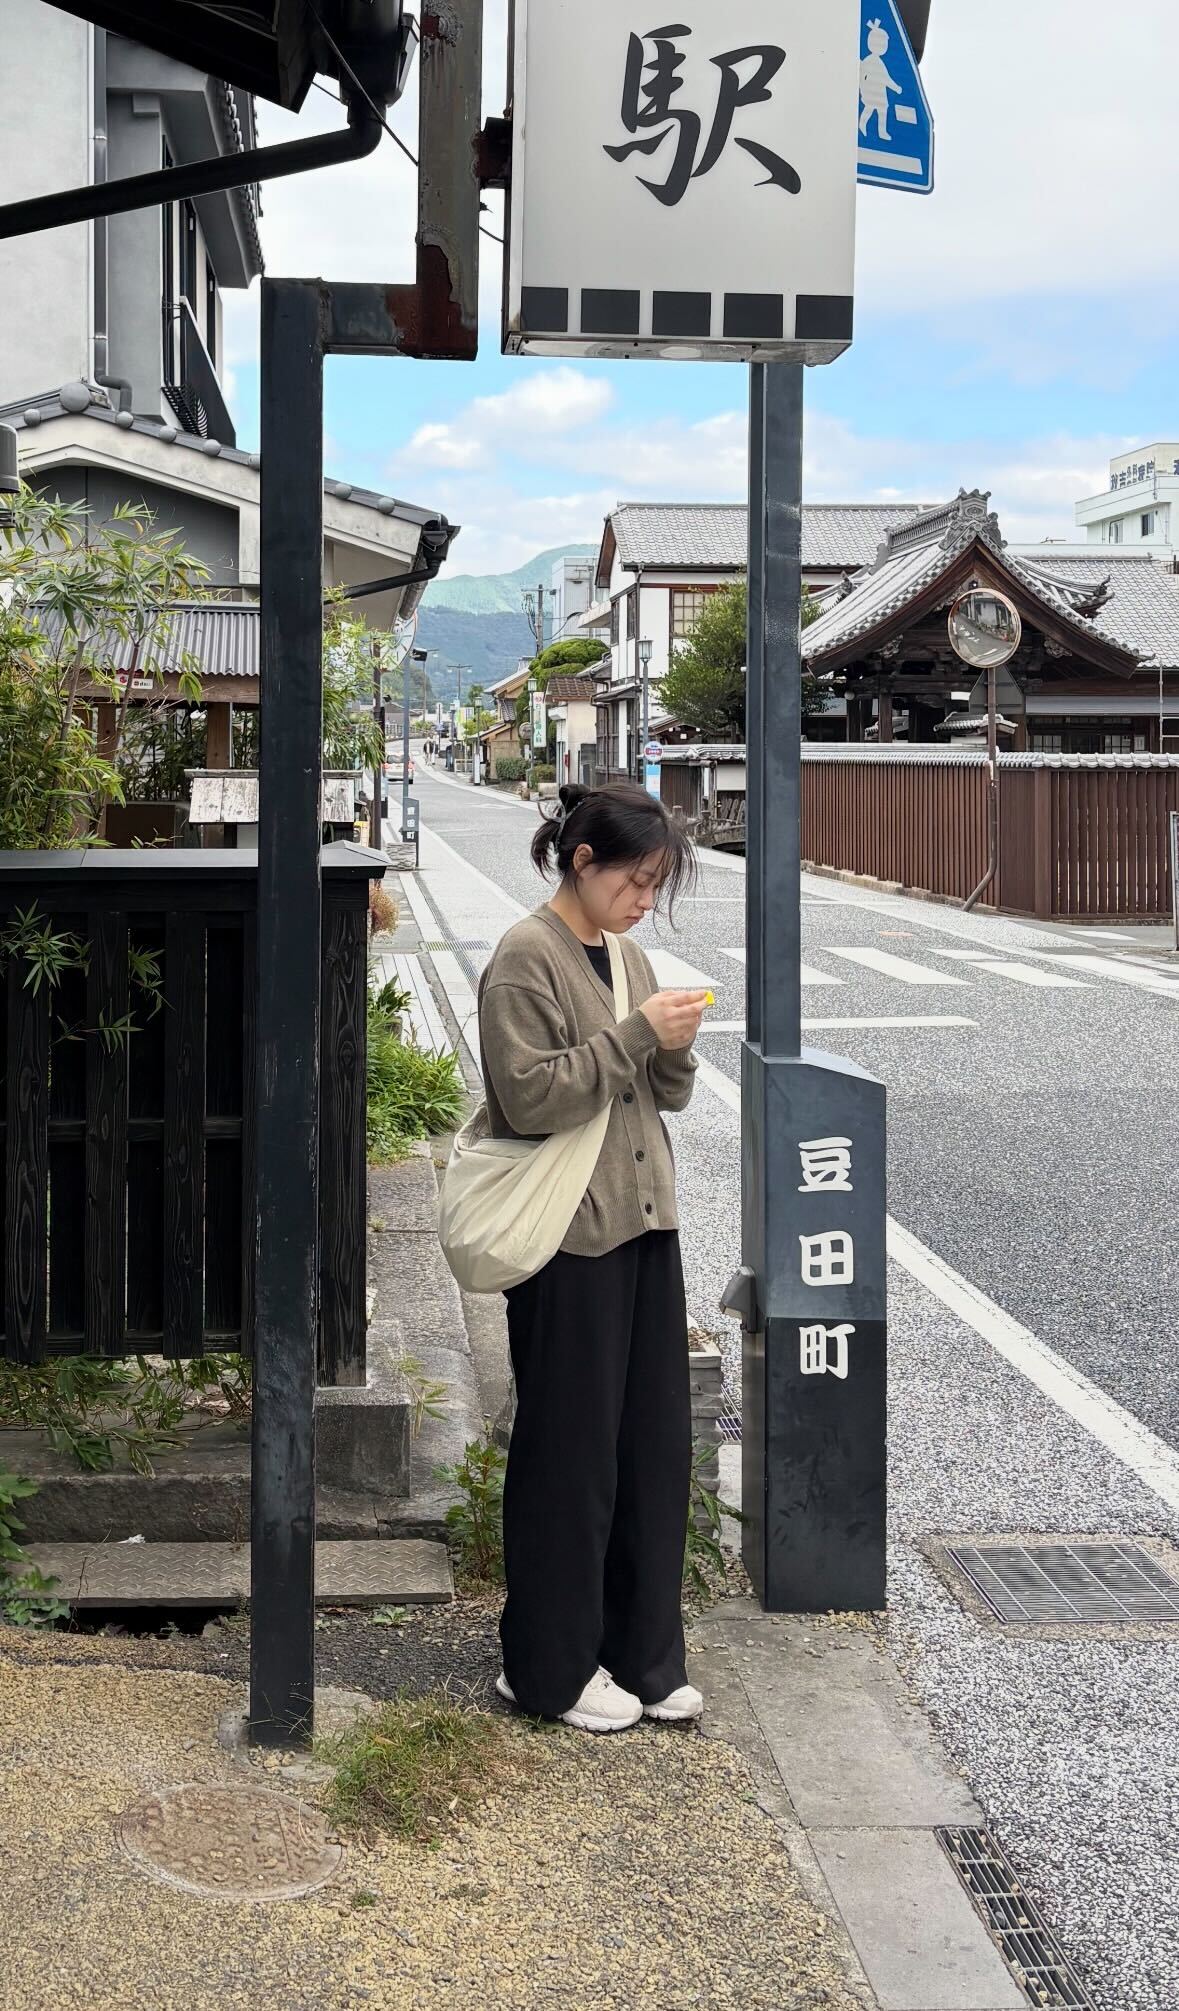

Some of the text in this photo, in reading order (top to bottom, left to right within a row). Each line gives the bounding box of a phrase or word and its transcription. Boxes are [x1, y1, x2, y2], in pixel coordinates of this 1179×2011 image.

[602, 23, 801, 206] 駅
[797, 1136, 856, 1380] 豆田町
